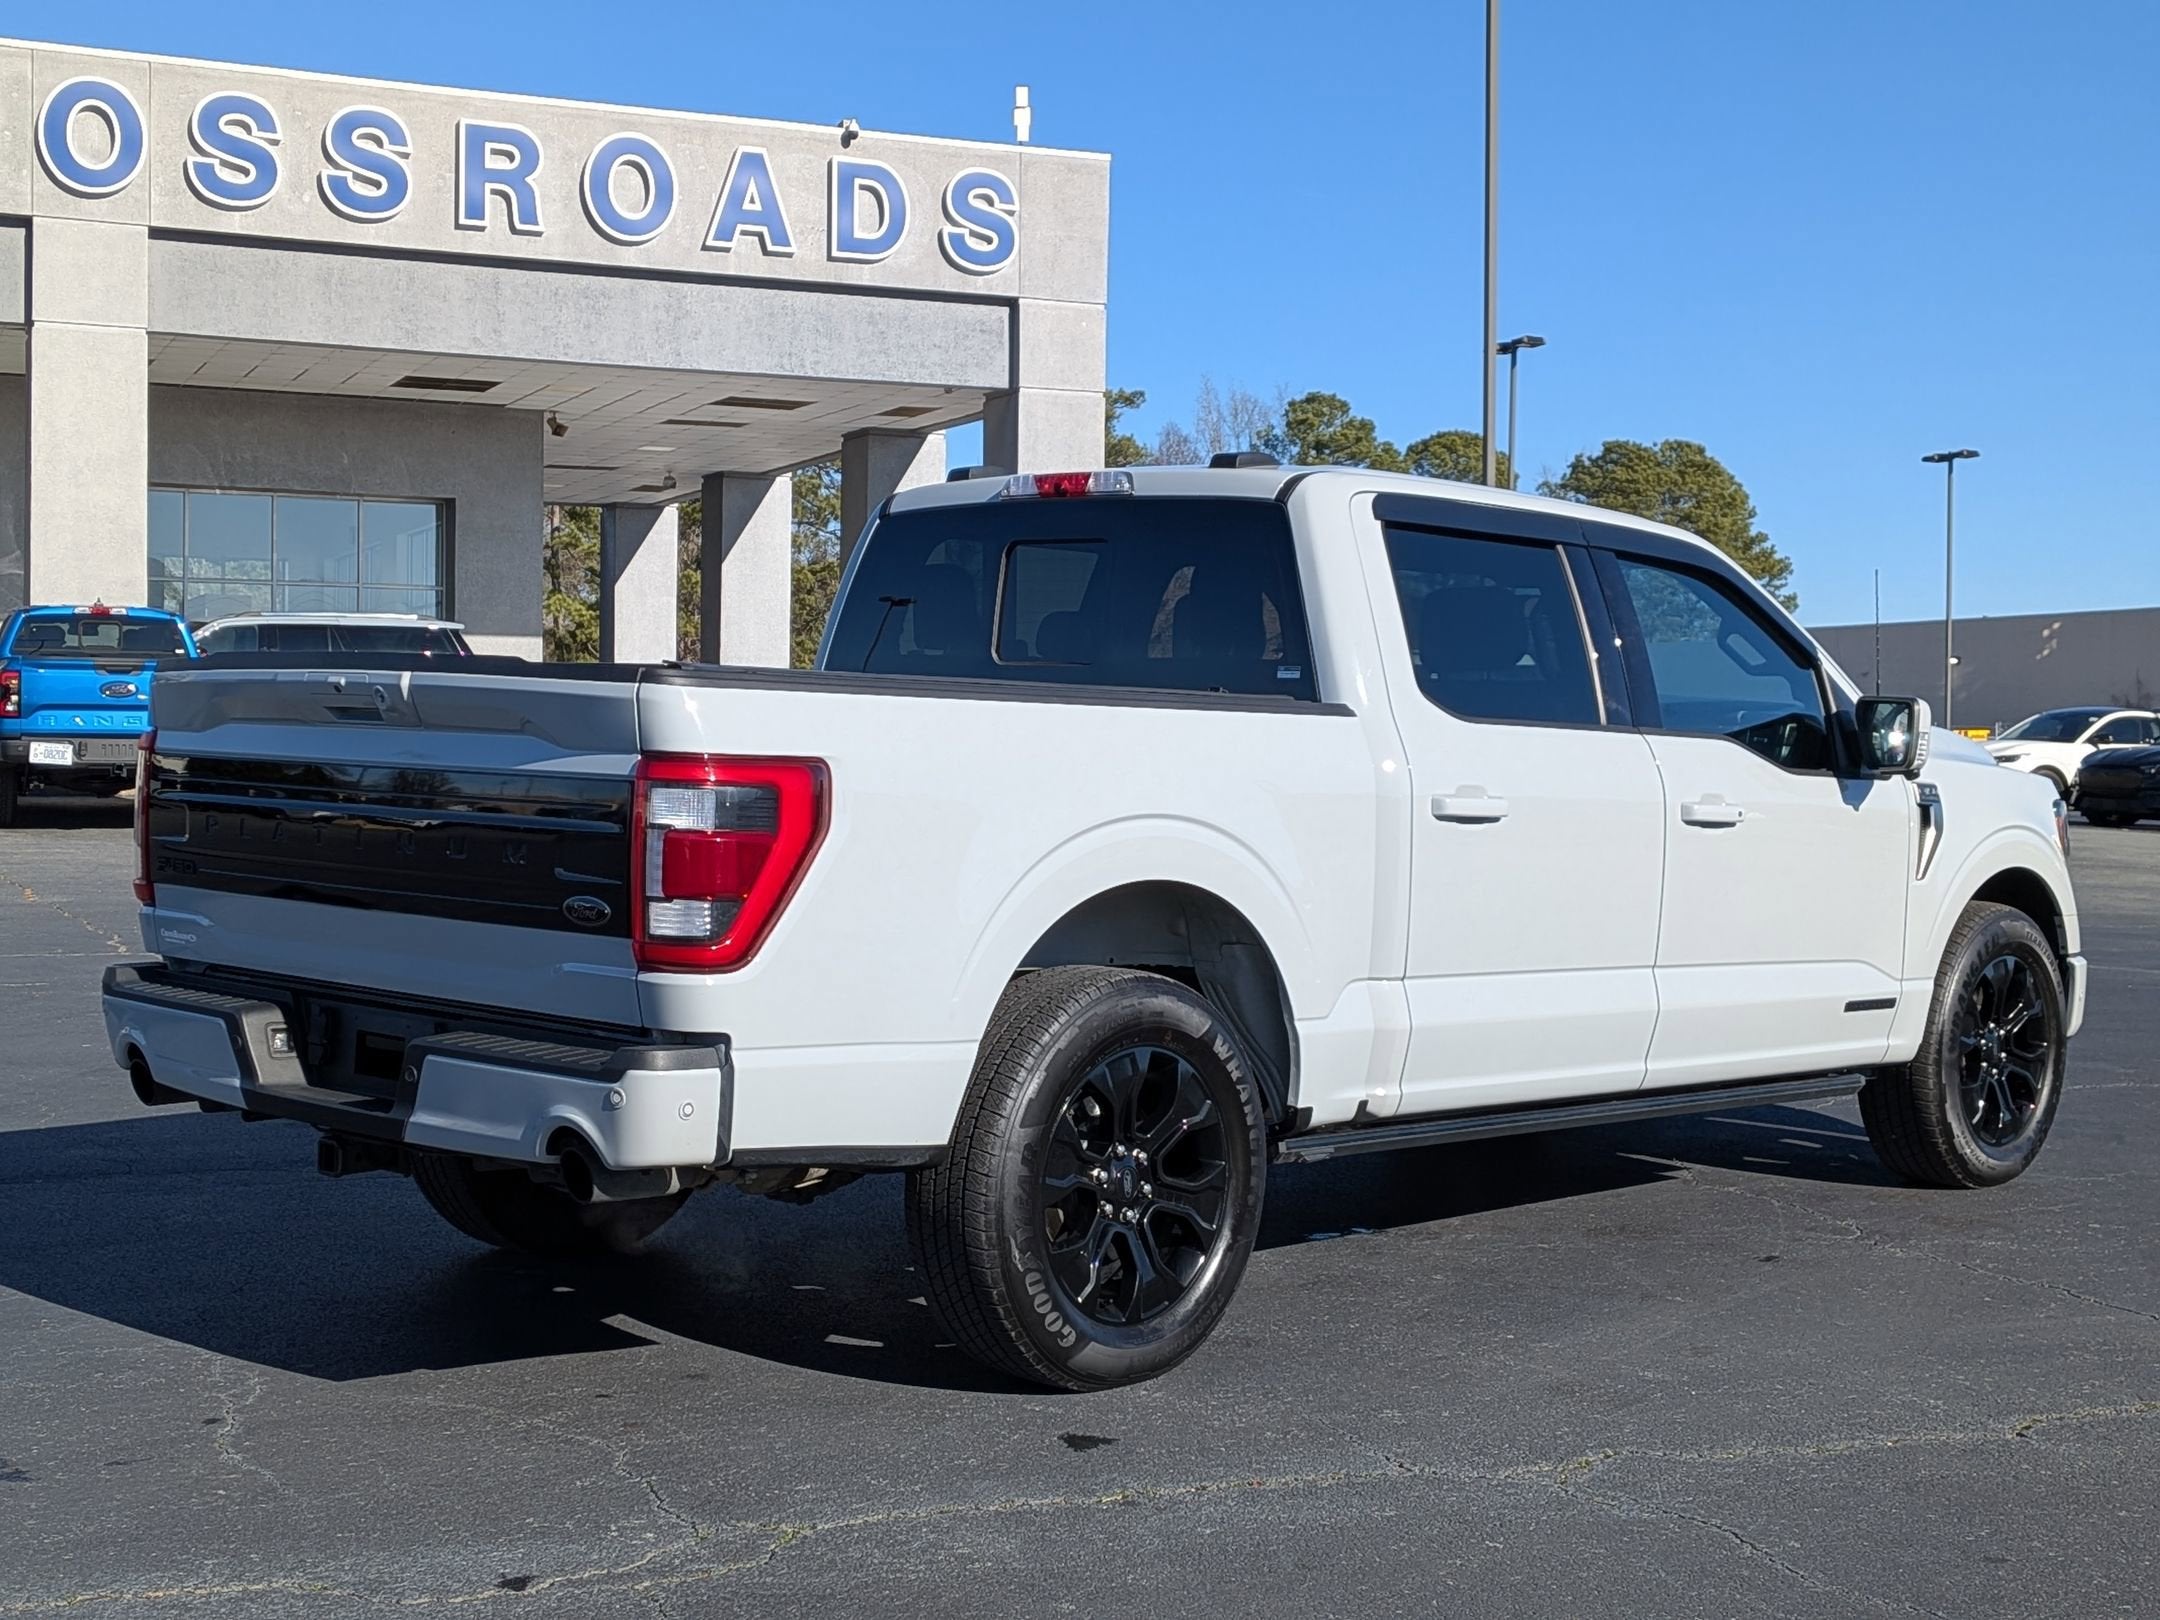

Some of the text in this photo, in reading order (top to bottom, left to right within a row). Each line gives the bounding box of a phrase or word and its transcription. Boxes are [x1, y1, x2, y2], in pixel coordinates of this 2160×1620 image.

[34, 75, 1020, 274] OSSROADS
[204, 813, 529, 865] PLATINUM
[570, 901, 598, 921] Ford
[1212, 1032, 1265, 1207] WRANGLER
